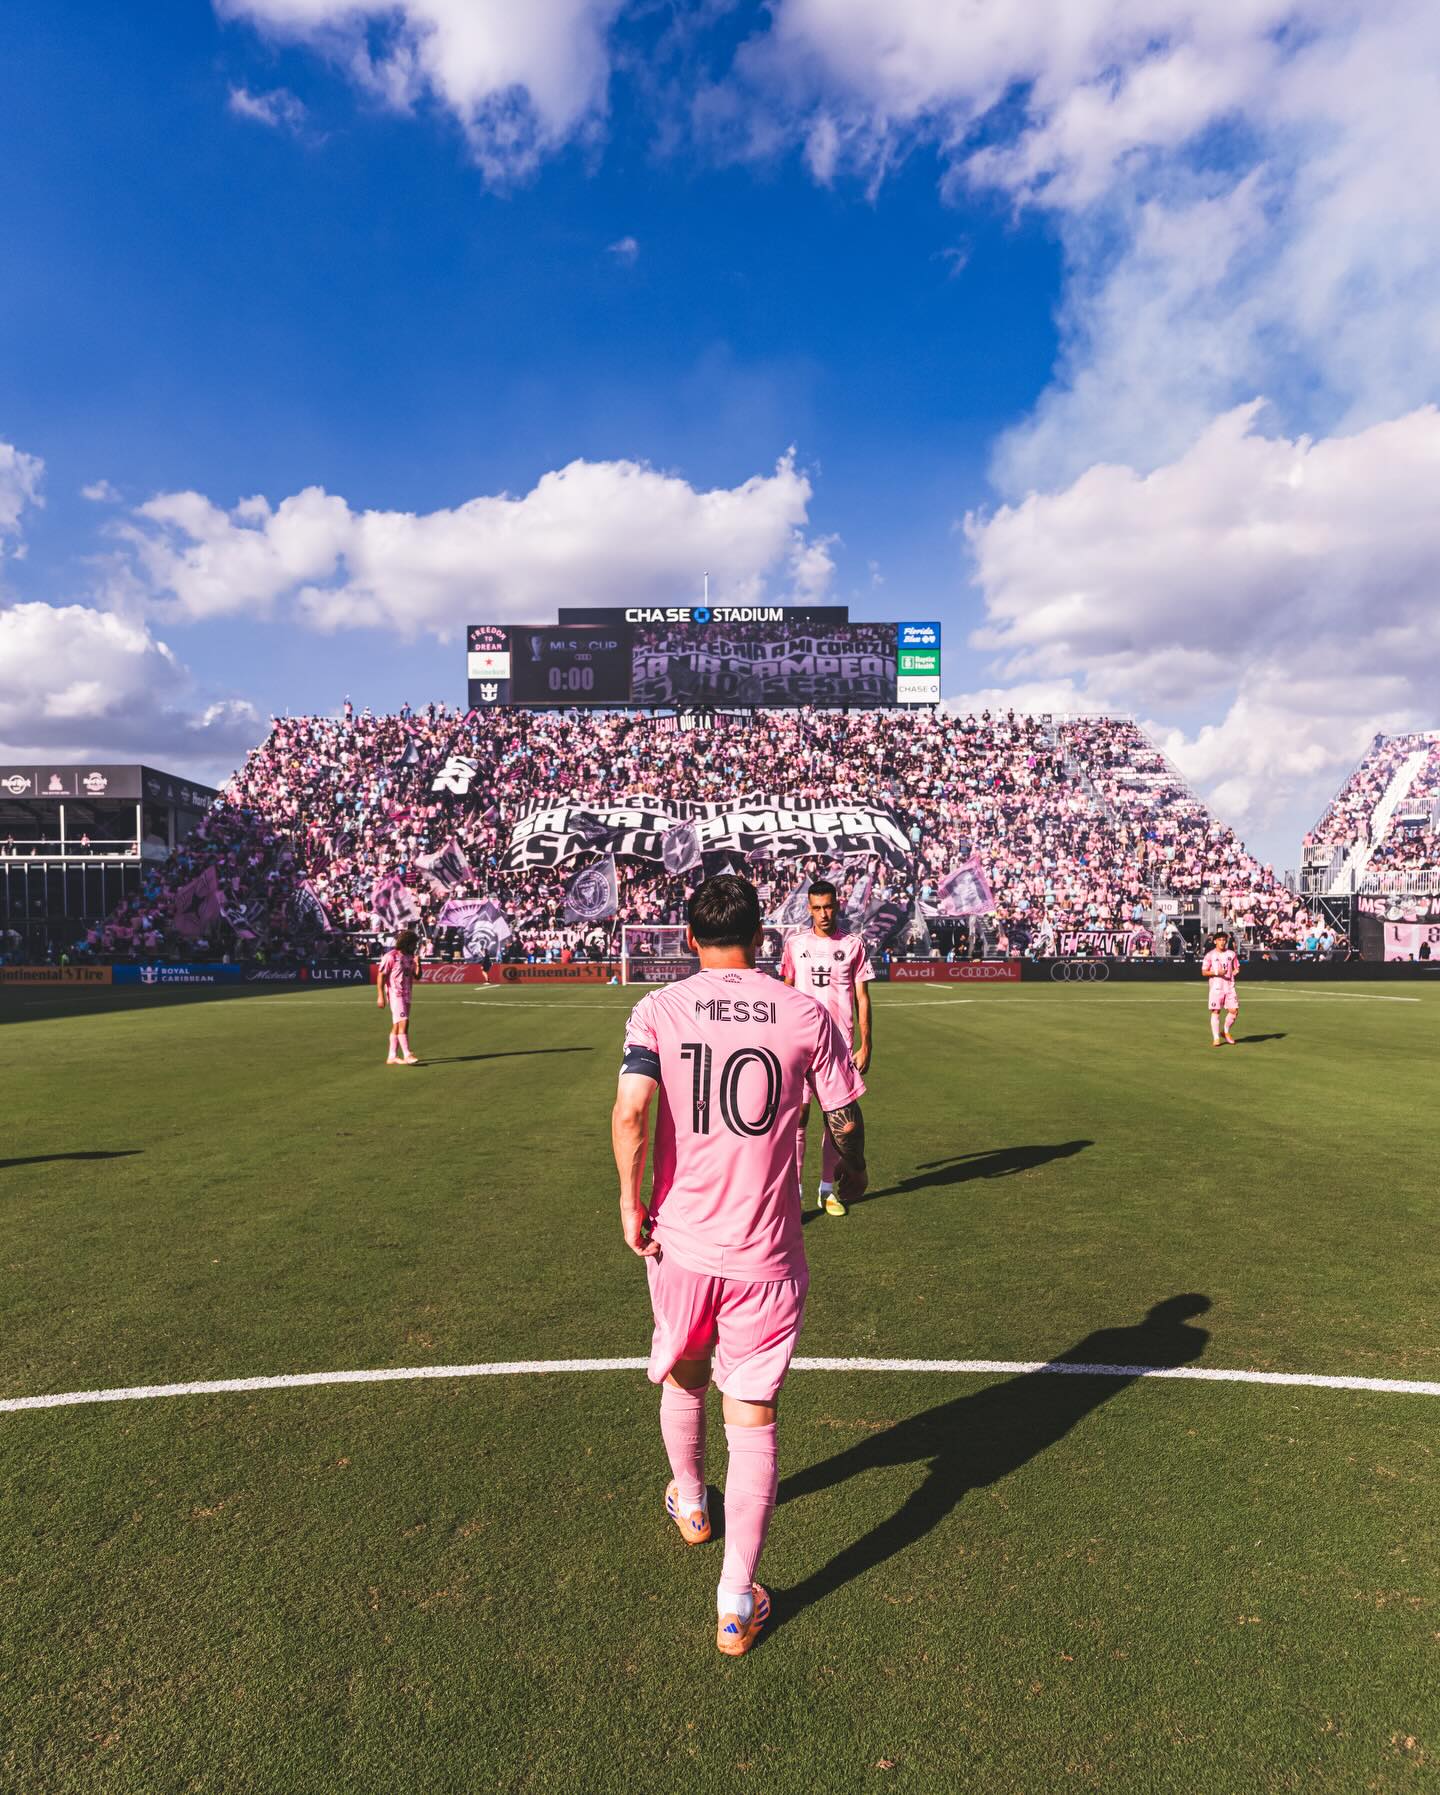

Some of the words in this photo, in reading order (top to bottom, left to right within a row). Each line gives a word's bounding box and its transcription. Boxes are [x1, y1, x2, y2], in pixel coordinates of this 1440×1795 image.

[625, 608, 691, 623] CHASE
[712, 608, 783, 622] STADIUM
[470, 626, 507, 640] FREEDOM
[904, 626, 934, 635] Florida
[550, 640, 577, 649] MLS
[588, 640, 617, 649] CUP
[903, 635, 921, 643] Blue
[474, 643, 503, 651] DREAM
[817, 641, 895, 658] CORAZO
[549, 667, 594, 690] 0:00
[898, 685, 928, 694] CHASE
[680, 715, 696, 731] QUE
[739, 794, 771, 810] MI
[0, 968, 62, 981] ntinental
[74, 968, 104, 981] Tire
[161, 967, 190, 975] ROYAL
[311, 969, 363, 980] ULTRA
[421, 964, 467, 983] a-Cola
[503, 965, 580, 982] Continental
[895, 967, 935, 977] Audi
[696, 1000, 776, 1024] MESSI
[681, 1043, 782, 1138] 10
